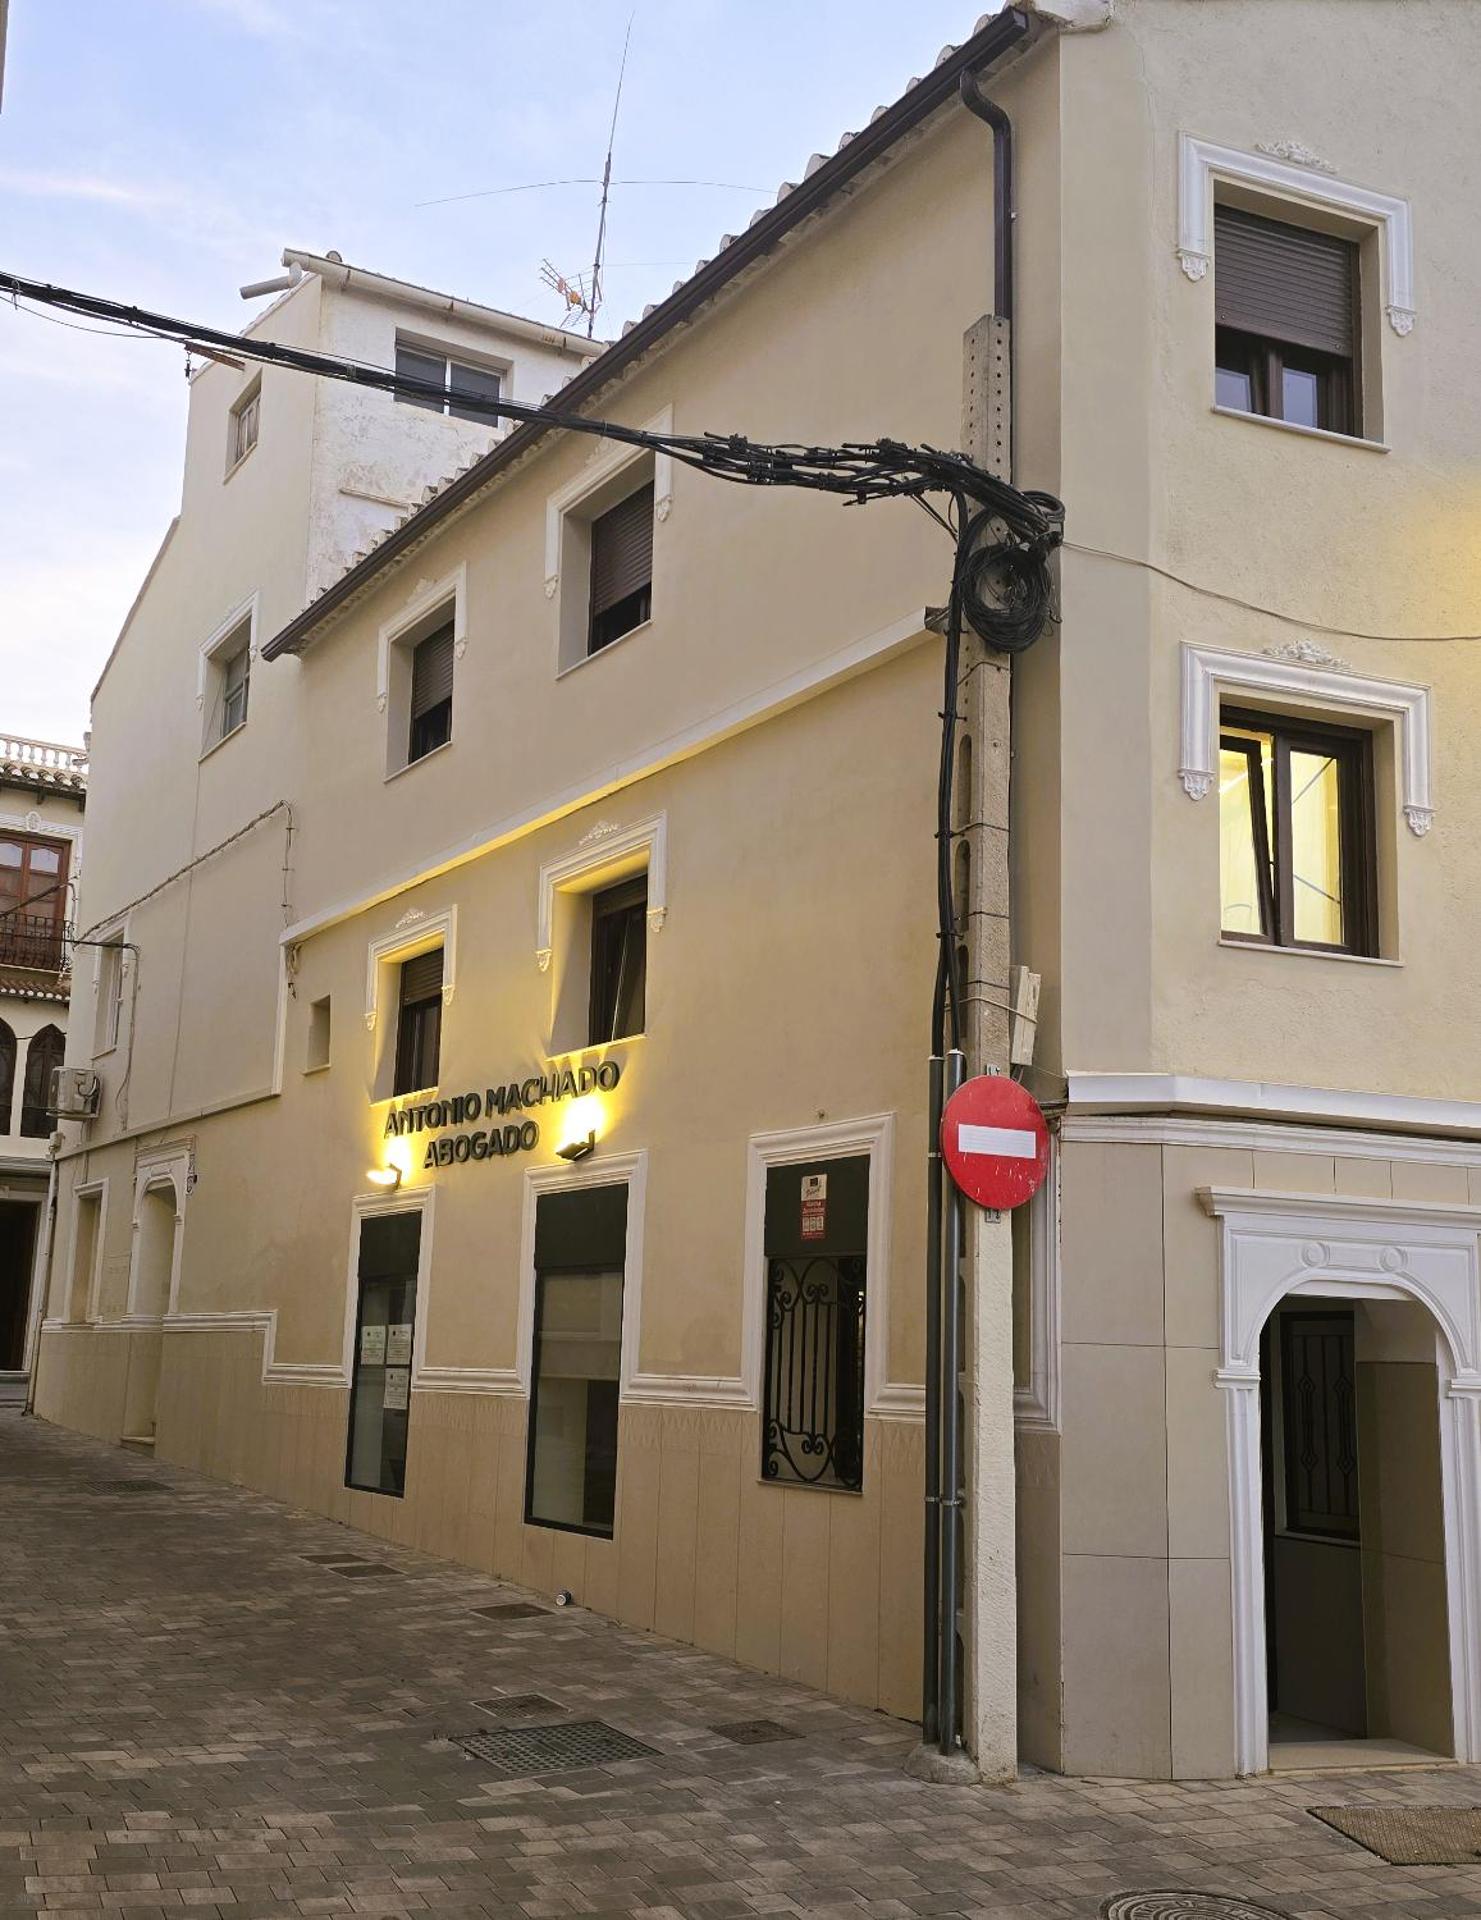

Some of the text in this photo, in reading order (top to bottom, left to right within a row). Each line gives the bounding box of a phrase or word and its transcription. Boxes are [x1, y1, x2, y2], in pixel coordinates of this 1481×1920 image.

[384, 1060, 621, 1139] ANTONIO MACHADO
[424, 1120, 540, 1169] ABOGADO
